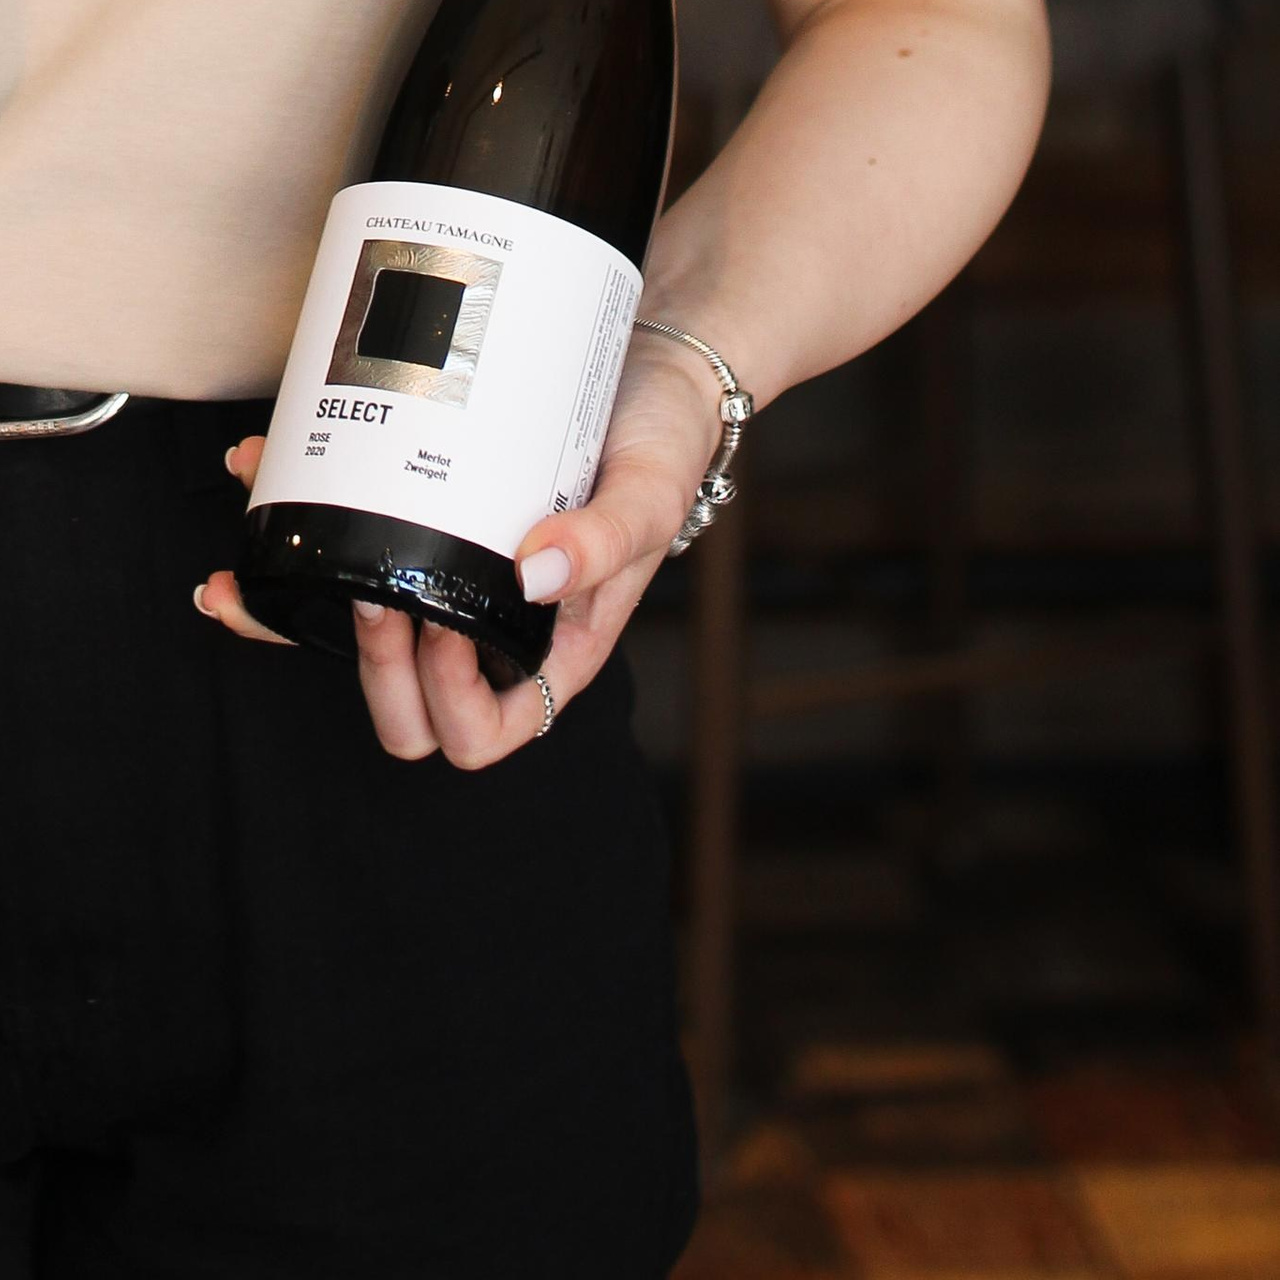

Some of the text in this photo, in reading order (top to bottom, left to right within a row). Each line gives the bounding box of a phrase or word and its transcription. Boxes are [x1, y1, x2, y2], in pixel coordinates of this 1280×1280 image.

[365, 216, 515, 252] CHATEAU TAMAGNE
[316, 398, 393, 425] SELECT
[304, 445, 326, 456] 2020
[417, 449, 452, 468] Merlot
[404, 461, 448, 482] Zweigelt
